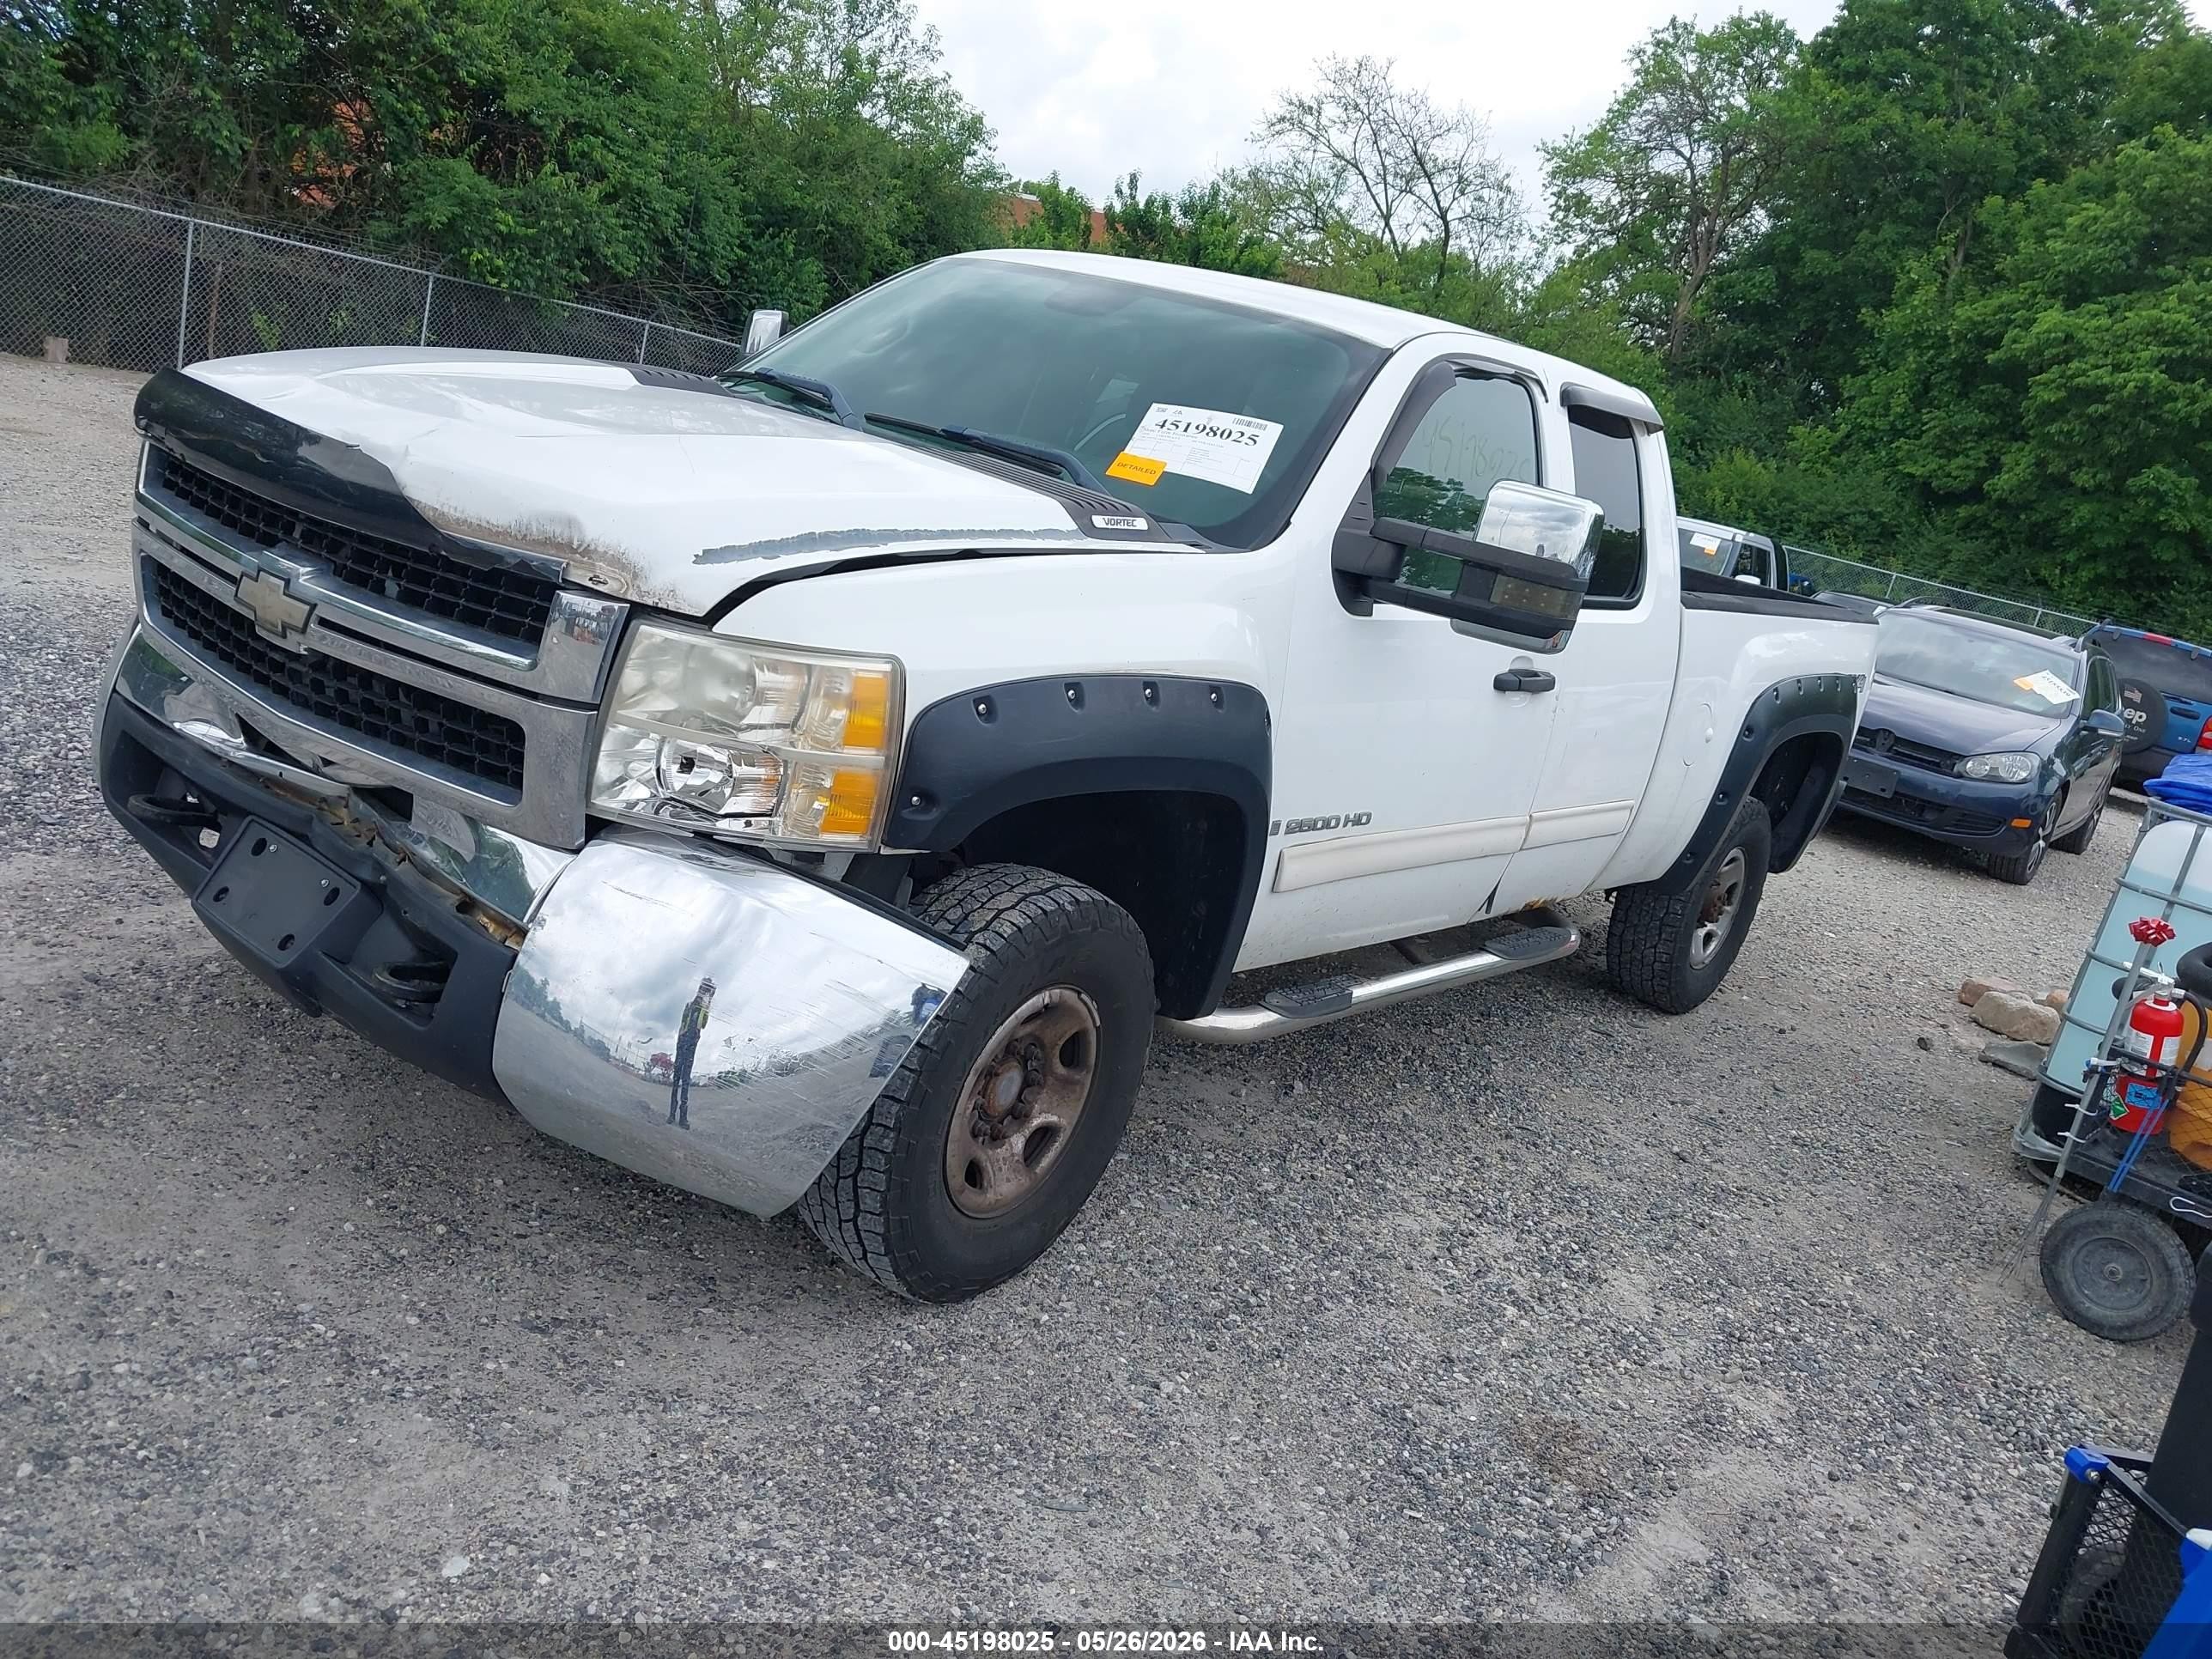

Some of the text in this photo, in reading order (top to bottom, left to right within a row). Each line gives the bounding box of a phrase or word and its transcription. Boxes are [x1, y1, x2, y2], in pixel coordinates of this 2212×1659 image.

[1155, 418, 1261, 447] 45198025
[1116, 462, 1157, 475] DETAILED
[1103, 517, 1138, 528] VORTEC
[2123, 707, 2148, 725] ep
[1284, 811, 1372, 836] 2500 HD
